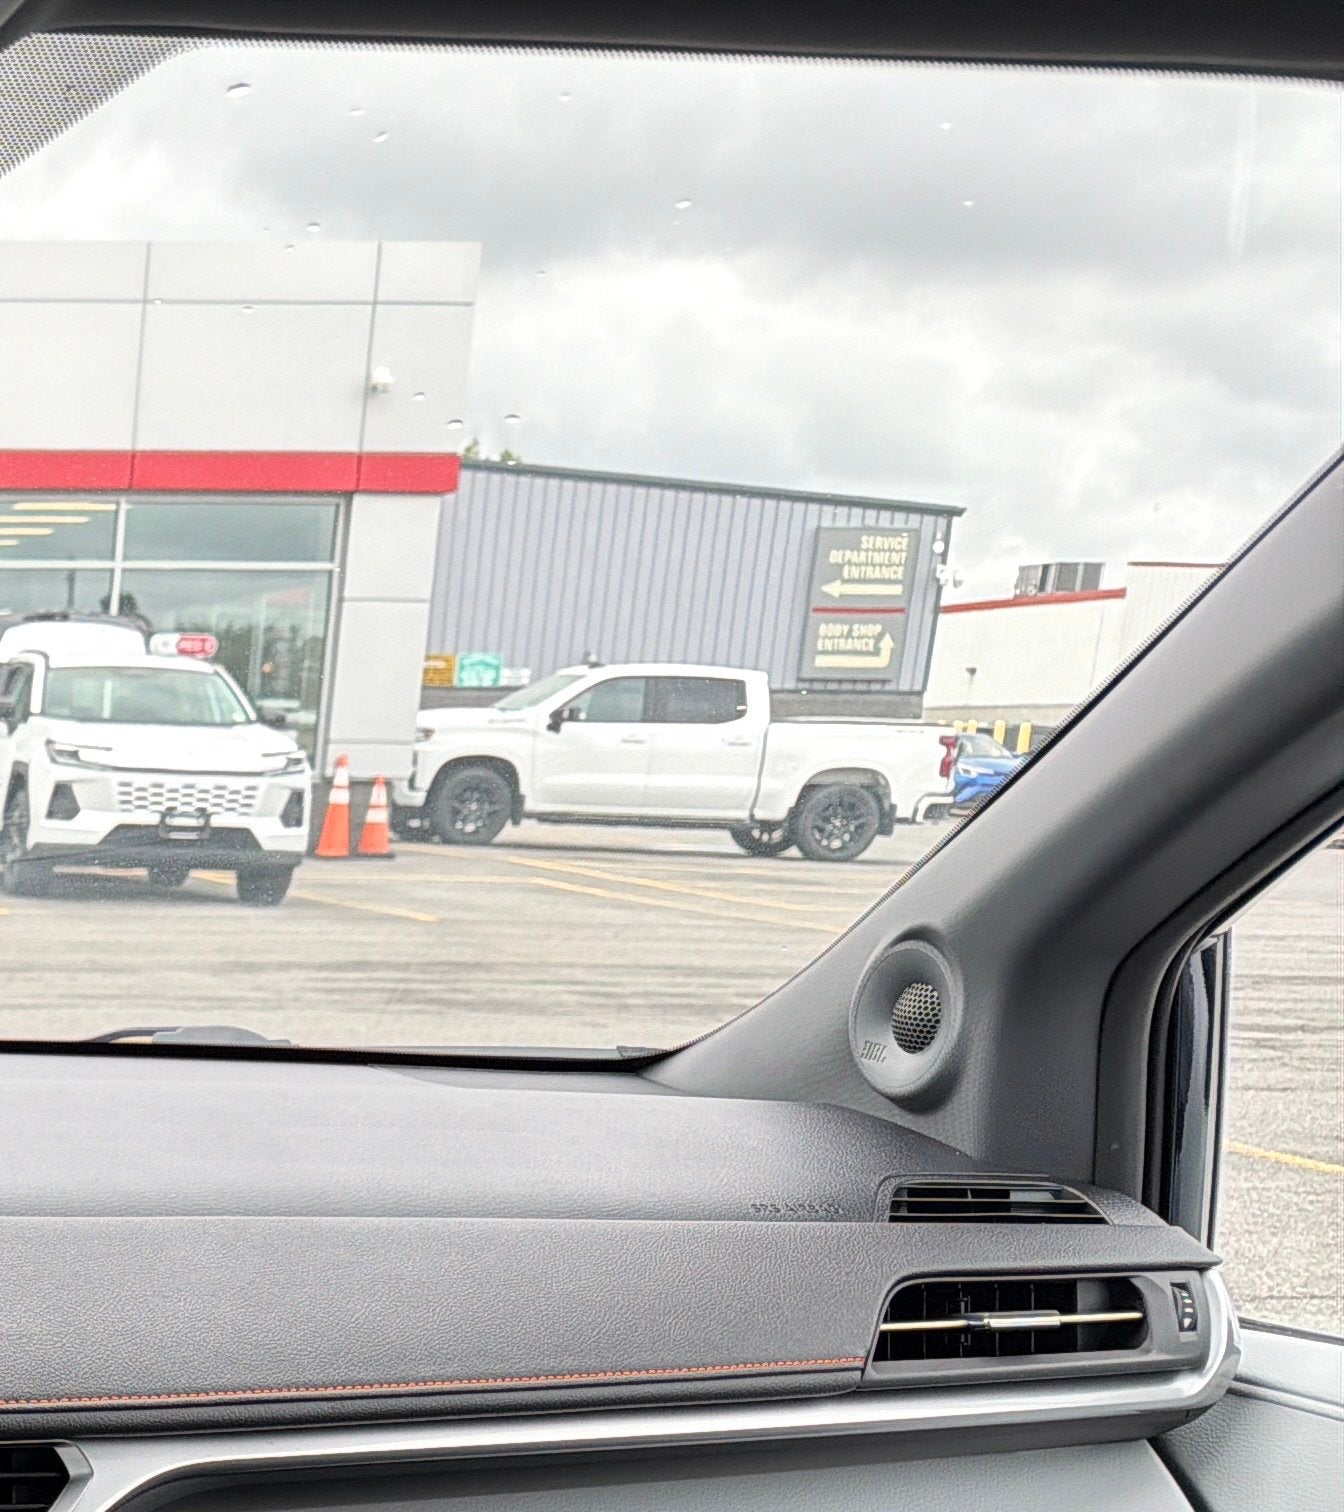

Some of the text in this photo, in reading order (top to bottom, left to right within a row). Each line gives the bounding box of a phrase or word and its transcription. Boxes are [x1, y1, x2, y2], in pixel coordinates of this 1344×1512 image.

[861, 535, 908, 550] SERVICE
[829, 550, 907, 564] DEPARTMENT
[843, 564, 905, 579] ENTRANCE
[818, 622, 882, 637] BODY SHOP
[816, 637, 875, 652] ENTRANCE
[861, 1040, 887, 1062] JBL
